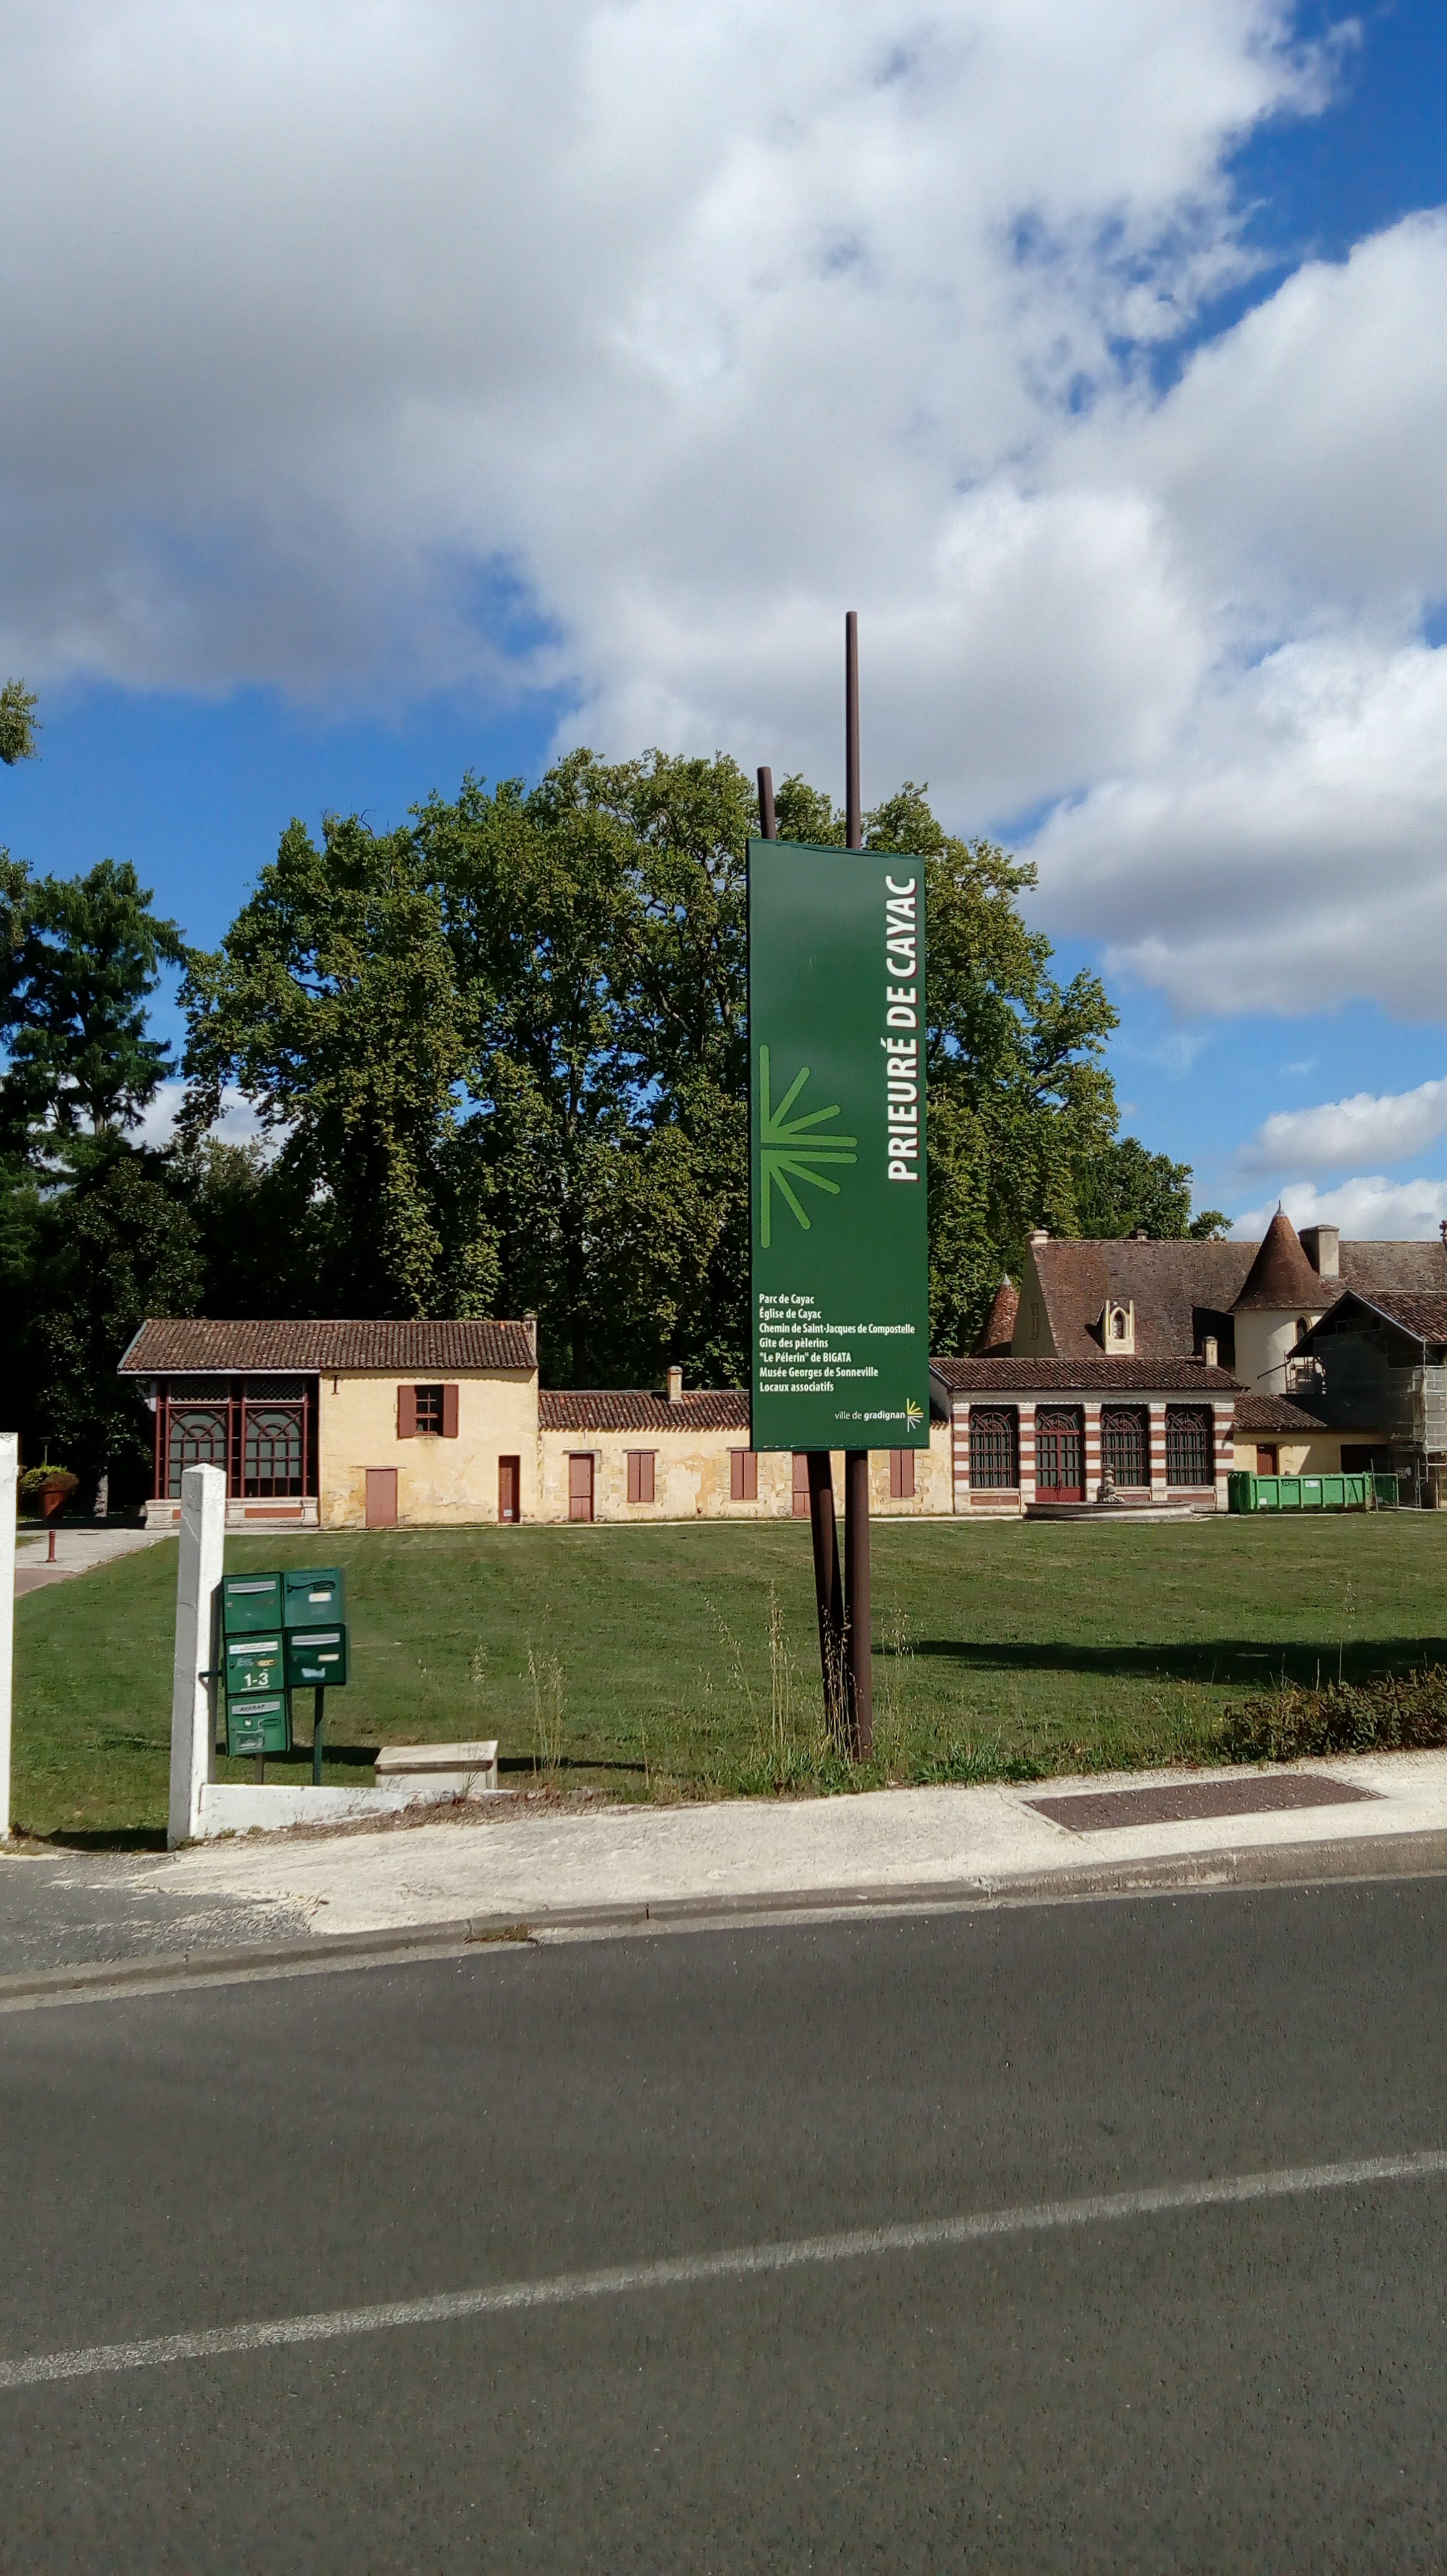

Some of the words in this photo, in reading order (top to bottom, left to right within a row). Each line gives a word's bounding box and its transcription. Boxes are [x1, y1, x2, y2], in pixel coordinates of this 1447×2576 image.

[886, 875, 916, 977] CAYAC
[887, 986, 916, 1028] DE
[881, 1038, 917, 1180] PRIEURÉ
[759, 1294, 777, 1303] Parc
[779, 1294, 789, 1303] de
[791, 1294, 815, 1306] Cayac
[759, 1307, 784, 1320] Église
[786, 1308, 796, 1318] de
[798, 1308, 821, 1320] Cayac
[759, 1323, 790, 1333] Chemin
[792, 1323, 801, 1333] de
[803, 1323, 856, 1335] Saint-Jacques
[857, 1324, 867, 1333] de
[868, 1324, 915, 1336] Compostelle
[779, 1338, 793, 1347] des
[795, 1338, 828, 1350] pèlerins
[759, 1352, 774, 1362] "Le
[776, 1352, 809, 1362] Pélerin"
[811, 1352, 821, 1362] de
[823, 1352, 852, 1362] BIGATA
[760, 1367, 787, 1377] Musée
[789, 1367, 822, 1379] Georges
[824, 1367, 834, 1377] de
[836, 1367, 878, 1377] Sonneville
[760, 1382, 789, 1392] Locaux
[791, 1382, 834, 1392] associatifs
[834, 1411, 850, 1419] ville
[852, 1411, 862, 1419] de
[864, 1410, 905, 1421] gradignan
